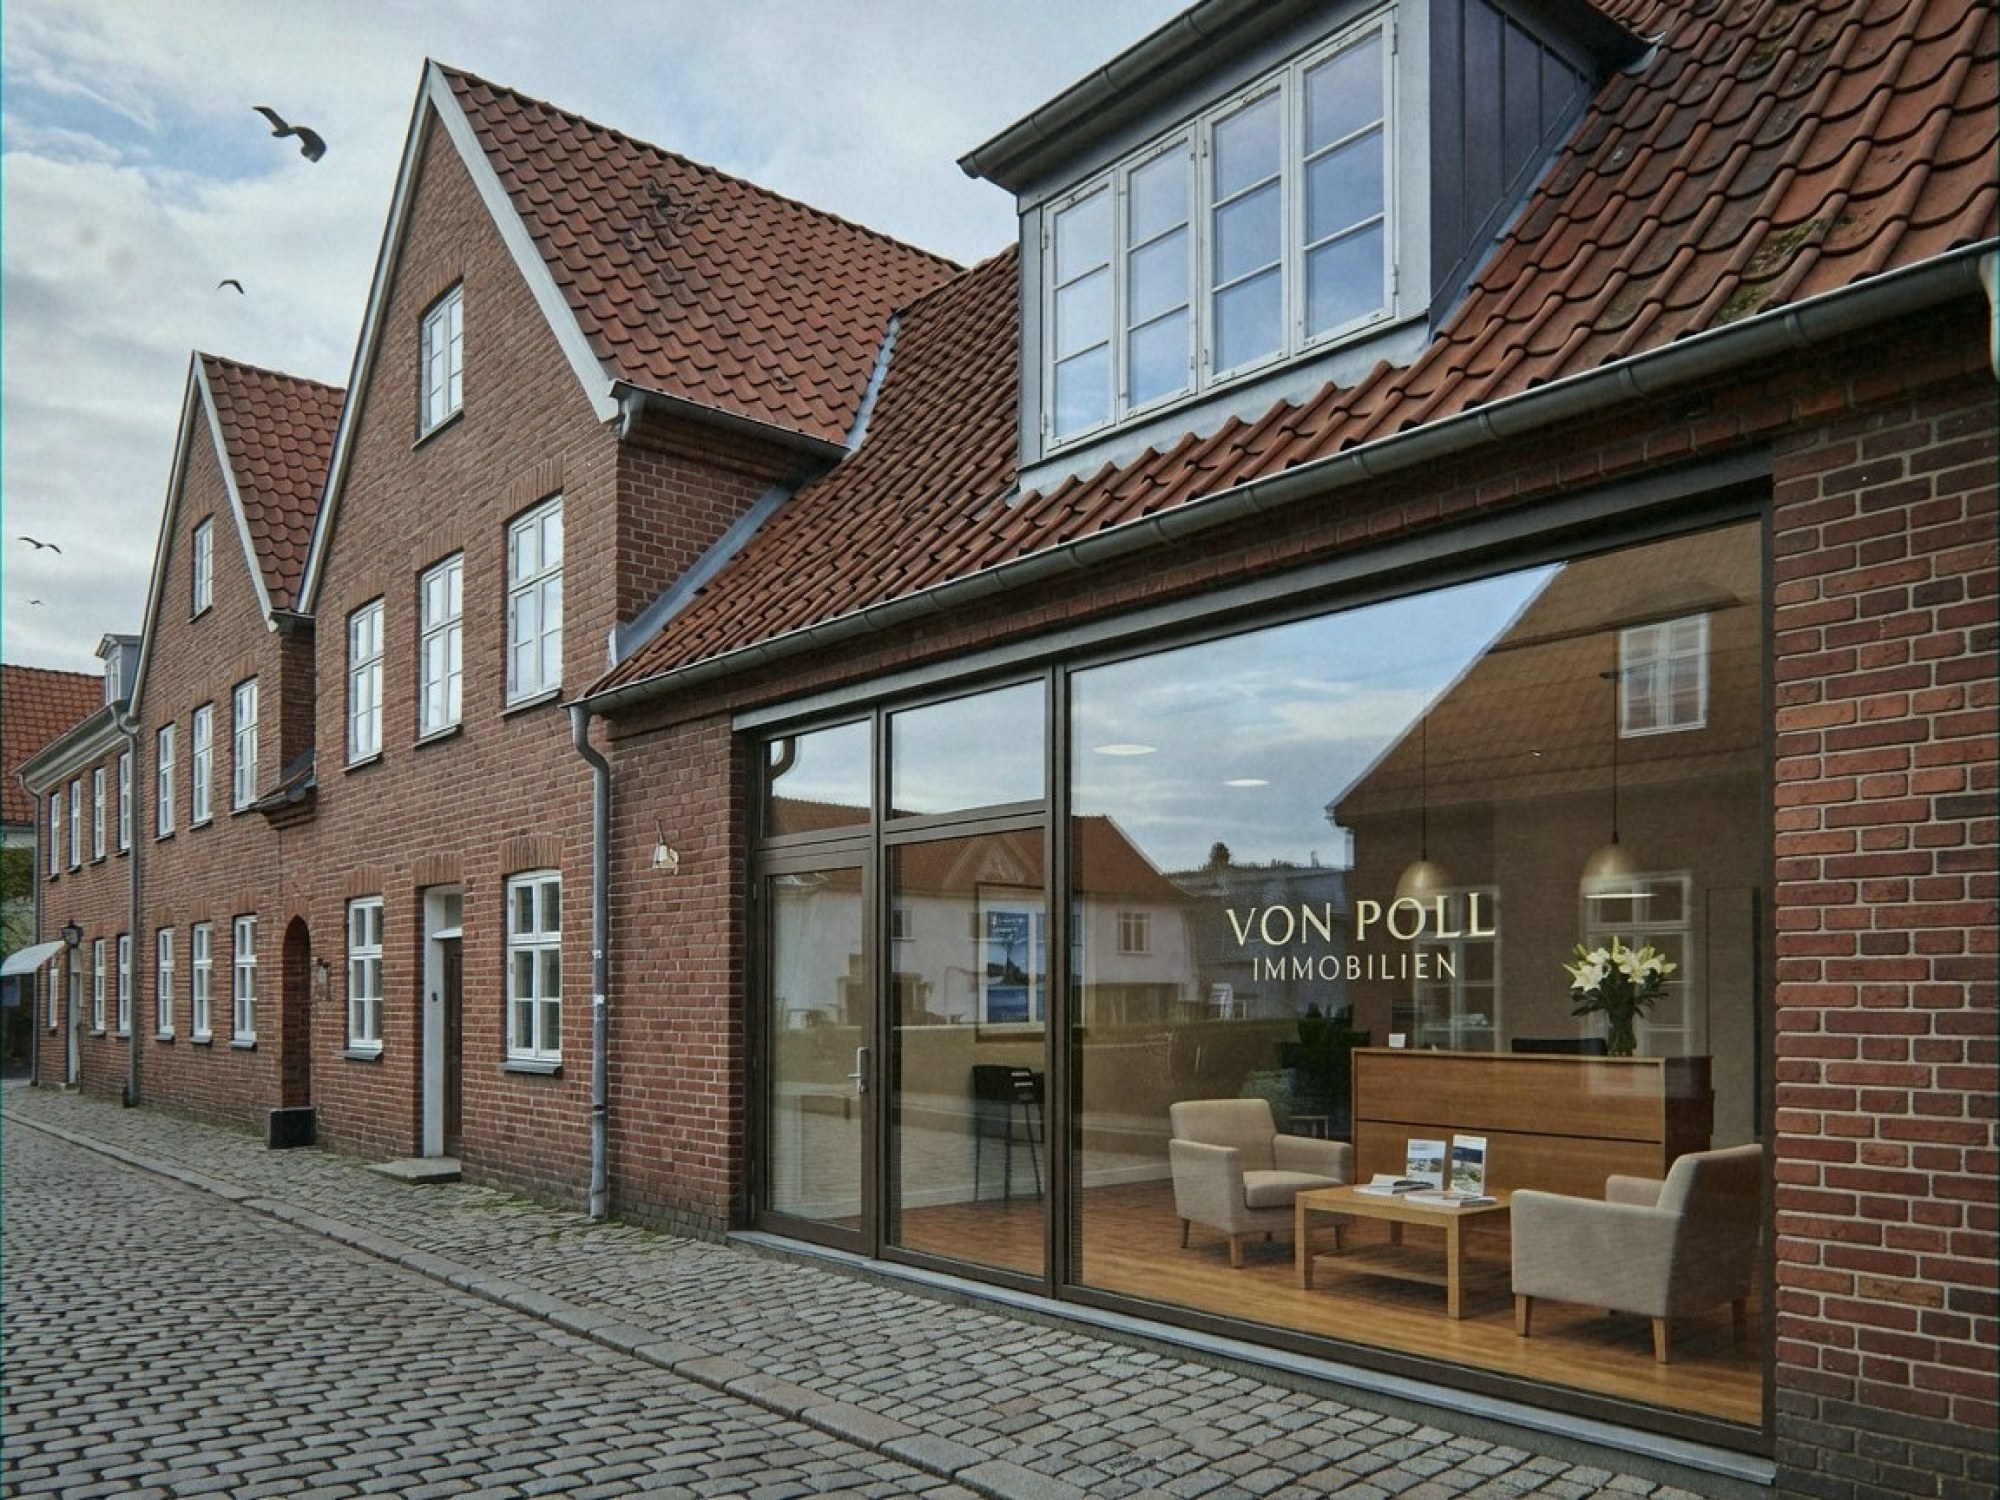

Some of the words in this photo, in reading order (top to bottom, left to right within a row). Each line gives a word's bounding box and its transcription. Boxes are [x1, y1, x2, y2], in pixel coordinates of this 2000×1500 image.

[1225, 902, 1332, 946] VON
[1356, 892, 1497, 942] POLL
[1253, 952, 1457, 982] IMMOBILIEN
